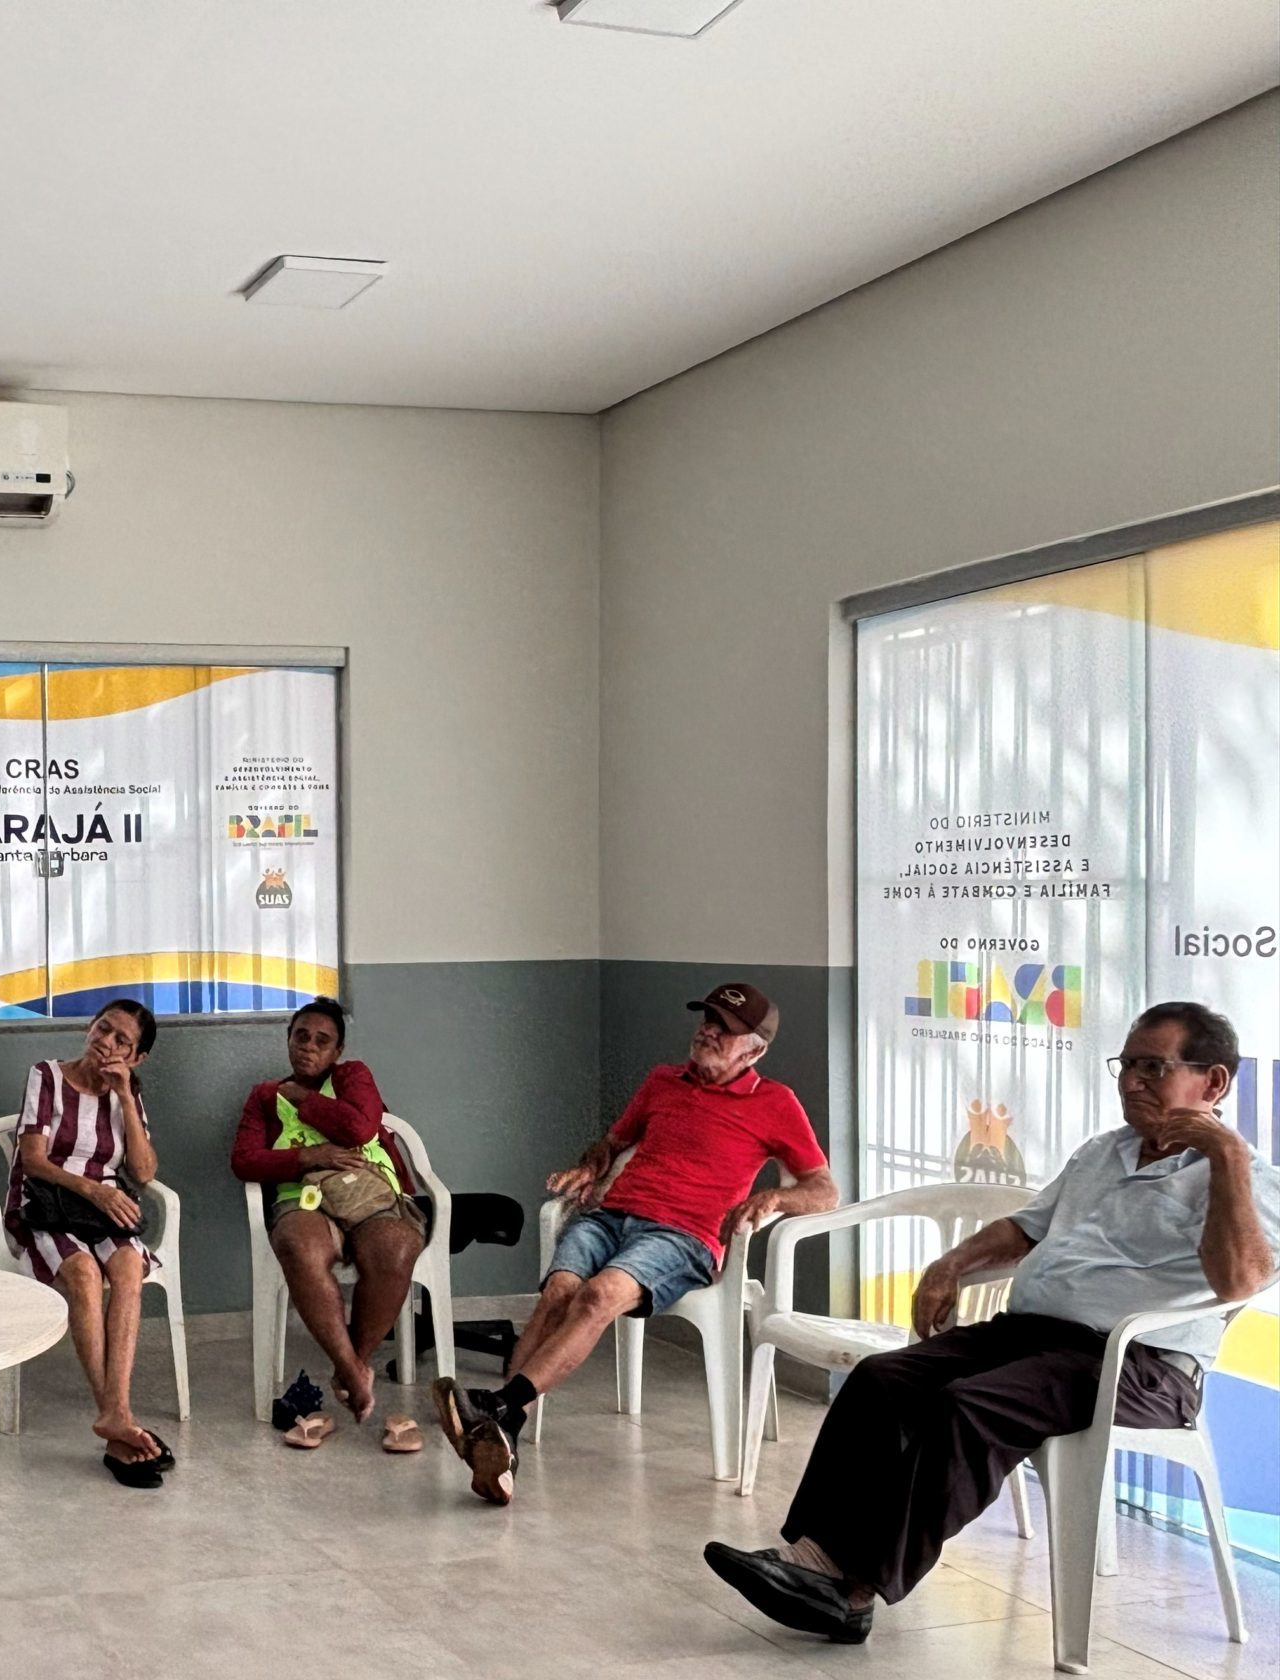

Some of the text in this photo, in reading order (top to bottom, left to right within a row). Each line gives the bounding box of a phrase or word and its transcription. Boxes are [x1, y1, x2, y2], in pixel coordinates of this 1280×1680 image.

[5, 758, 80, 780] CRAS
[63, 784, 126, 795] Assistência
[128, 784, 161, 795] Social
[123, 814, 142, 843] II
[228, 814, 318, 838] BRASIL
[38, 848, 108, 862] rbara
[258, 894, 290, 905] SUAS
